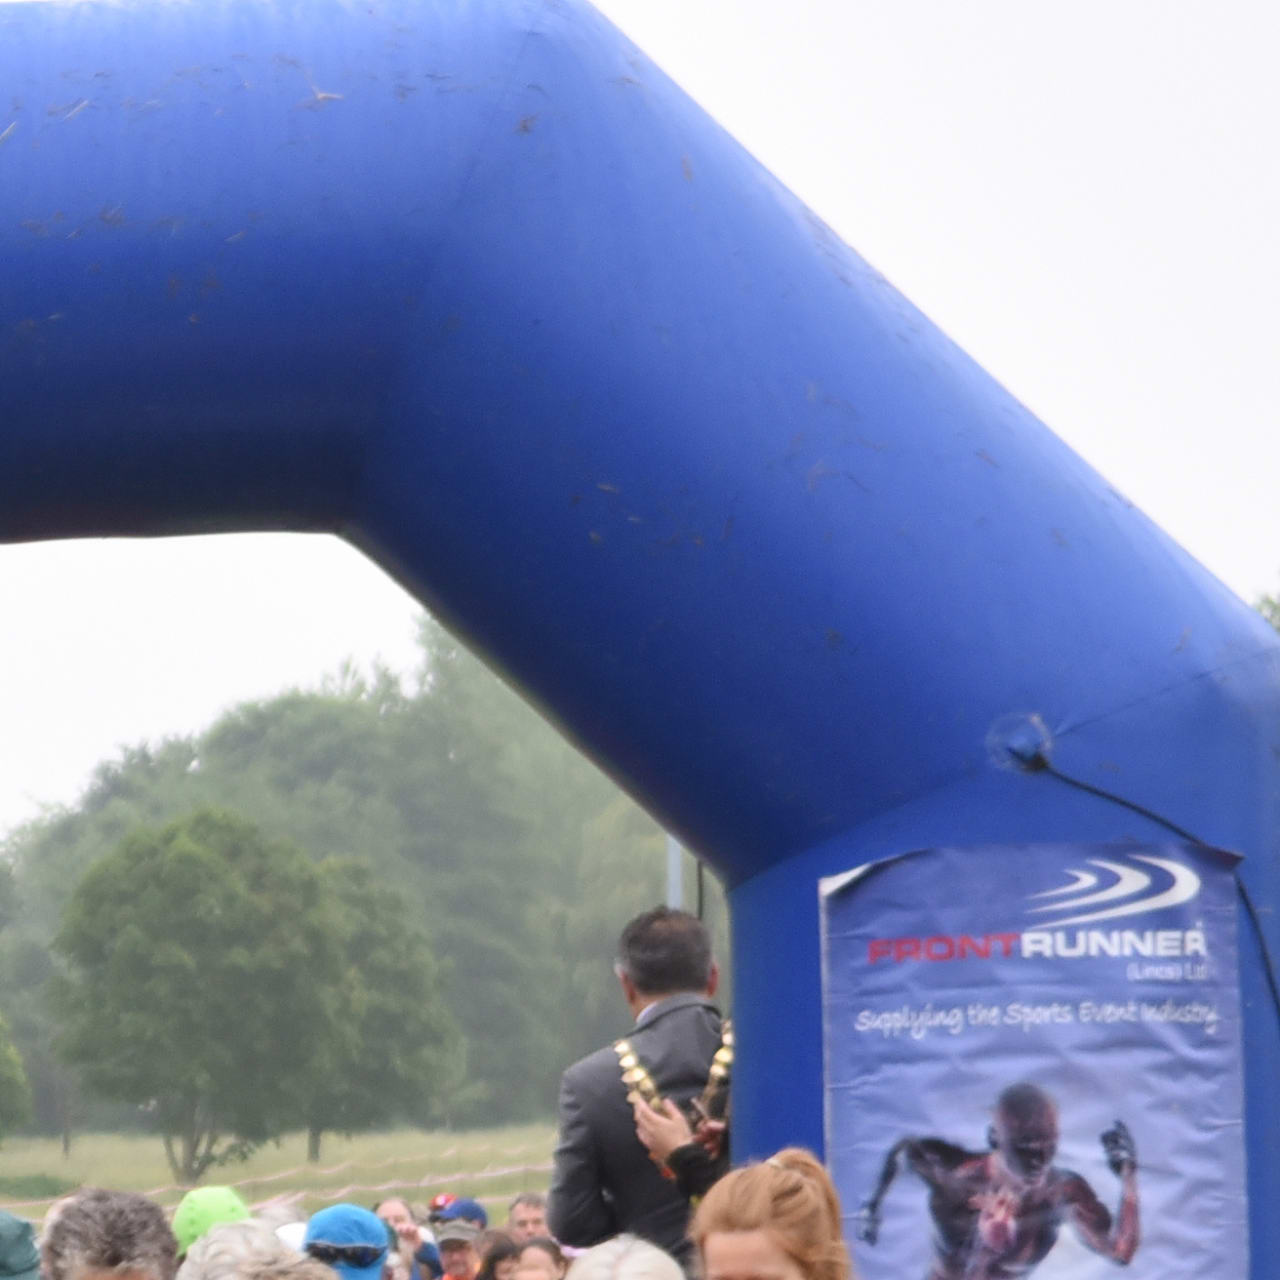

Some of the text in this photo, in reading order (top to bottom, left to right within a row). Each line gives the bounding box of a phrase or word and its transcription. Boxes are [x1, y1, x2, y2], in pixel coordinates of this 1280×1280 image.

[868, 929, 1208, 965] FRONTRUNNER
[854, 1006, 963, 1040] Supplying
[967, 1003, 999, 1025] the
[1003, 1002, 1074, 1032] Sports
[1078, 1001, 1138, 1023] Event
